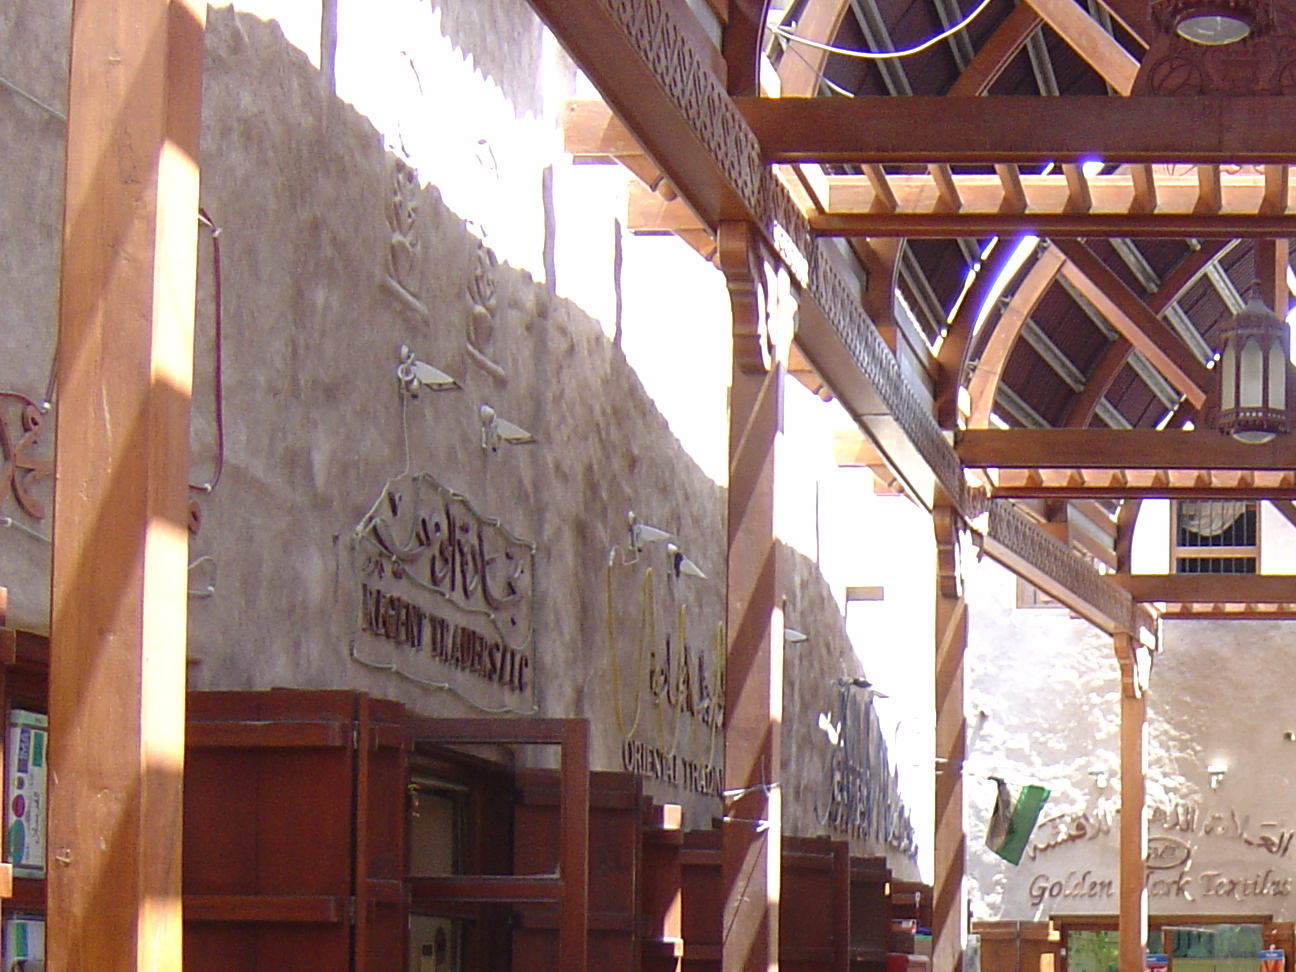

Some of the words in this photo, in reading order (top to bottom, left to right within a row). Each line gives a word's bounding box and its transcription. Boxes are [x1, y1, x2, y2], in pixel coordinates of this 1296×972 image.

[681, 756, 725, 799] TRADIN
[1029, 869, 1115, 907] Golden
[1145, 870, 1196, 902] ark
[1200, 868, 1293, 902] Textiles
